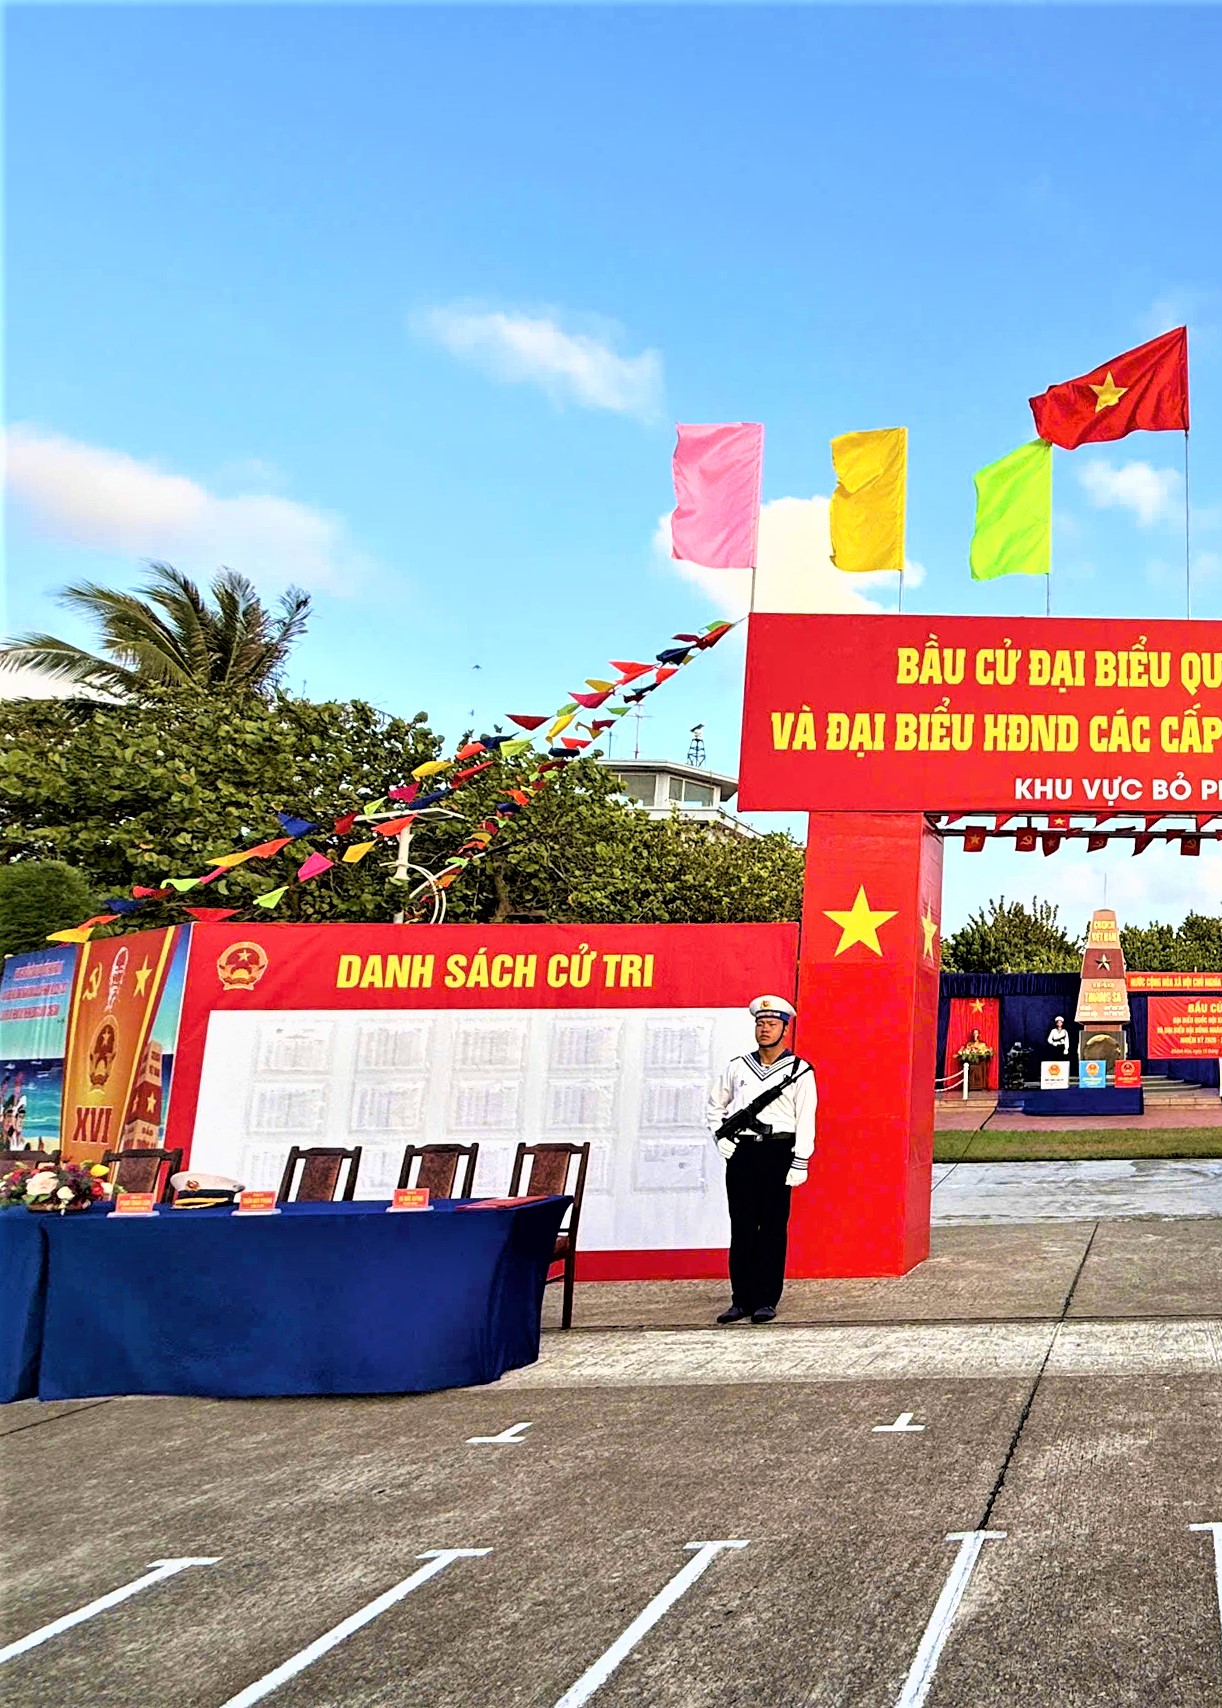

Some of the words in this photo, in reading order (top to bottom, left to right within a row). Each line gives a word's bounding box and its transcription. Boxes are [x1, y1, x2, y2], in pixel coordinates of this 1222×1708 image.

[896, 634, 967, 685] BẦU
[976, 639, 1022, 686] CỬ
[1029, 649, 1086, 692] ĐẠI
[1094, 635, 1171, 688] BIỂU
[771, 704, 817, 751] VÀ
[827, 712, 885, 757] ĐẠI
[895, 698, 975, 751] BIỂU
[984, 714, 1079, 752] HĐND
[1089, 708, 1151, 753] CÁC
[1015, 779, 1073, 800] KHU
[1082, 776, 1143, 807] VỰC
[1153, 772, 1192, 801] BỎ
[336, 954, 435, 989] DANH
[444, 947, 537, 988] SÁCH
[547, 943, 598, 988] CỬ
[602, 954, 654, 988] TRI
[1112, 990, 1121, 1002] SA
[72, 1104, 113, 1144] XVI
